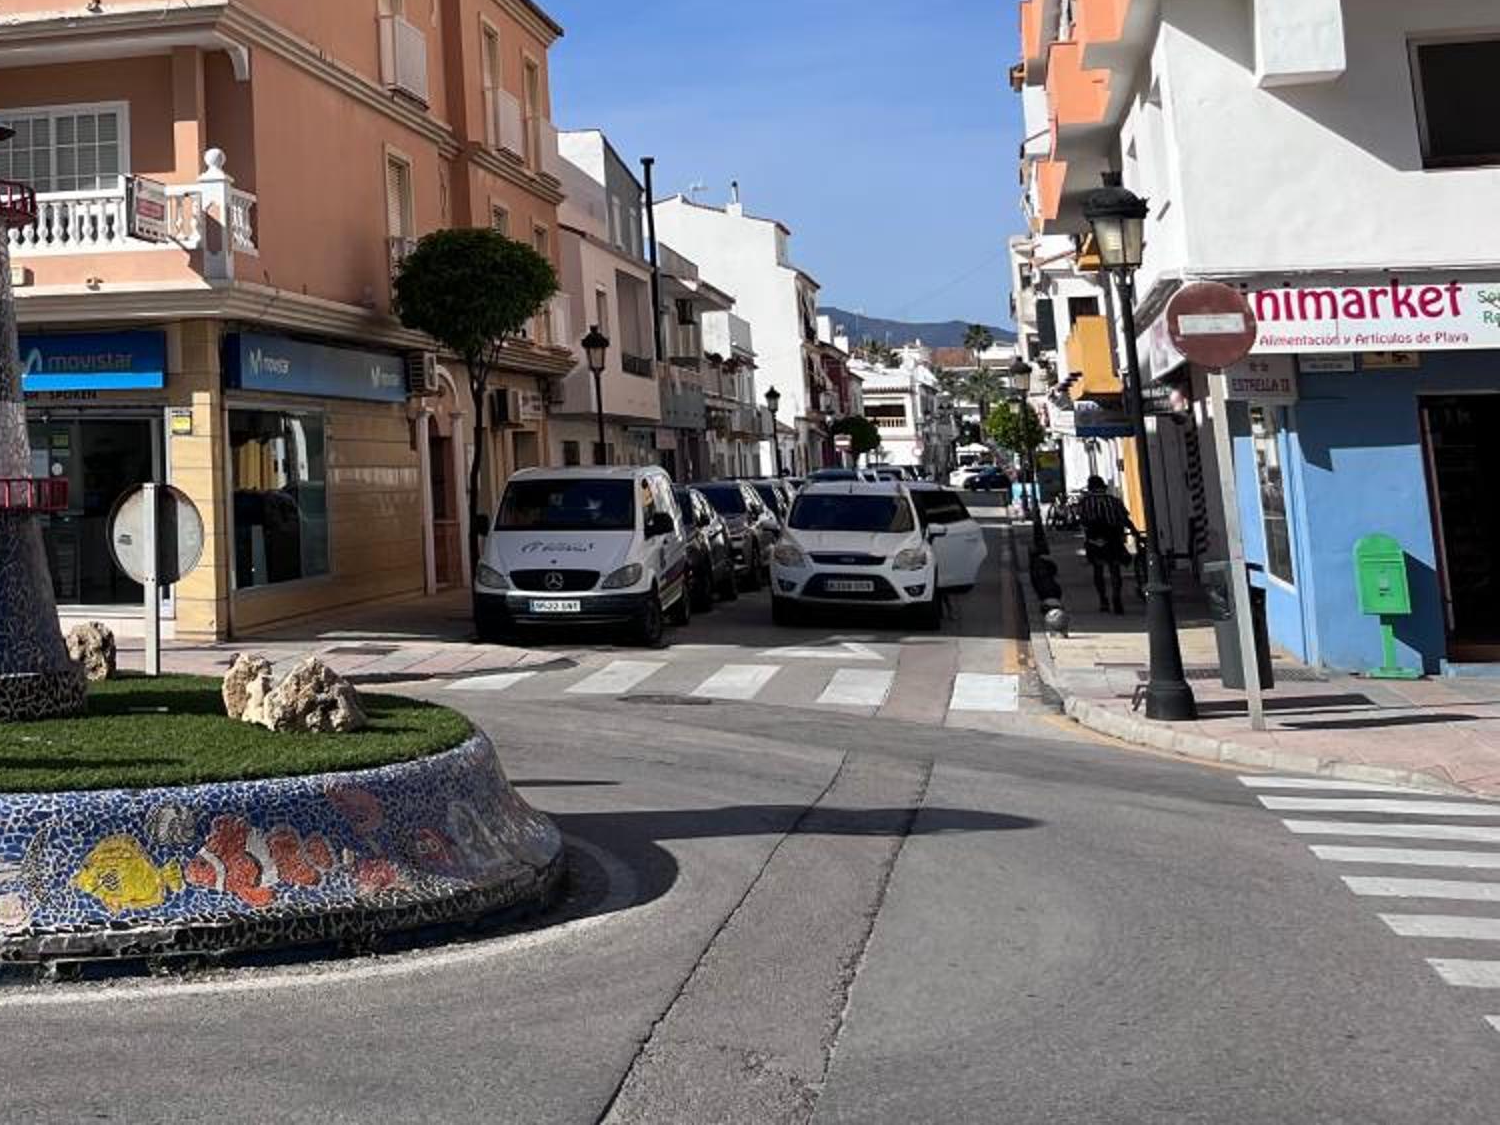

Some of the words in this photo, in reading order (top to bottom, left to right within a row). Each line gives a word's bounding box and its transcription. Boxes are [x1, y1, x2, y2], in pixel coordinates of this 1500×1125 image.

[1241, 278, 1463, 321] nimarket
[1416, 330, 1431, 343] de
[50, 353, 133, 371] movistar
[1231, 378, 1278, 393] ESTRELLA
